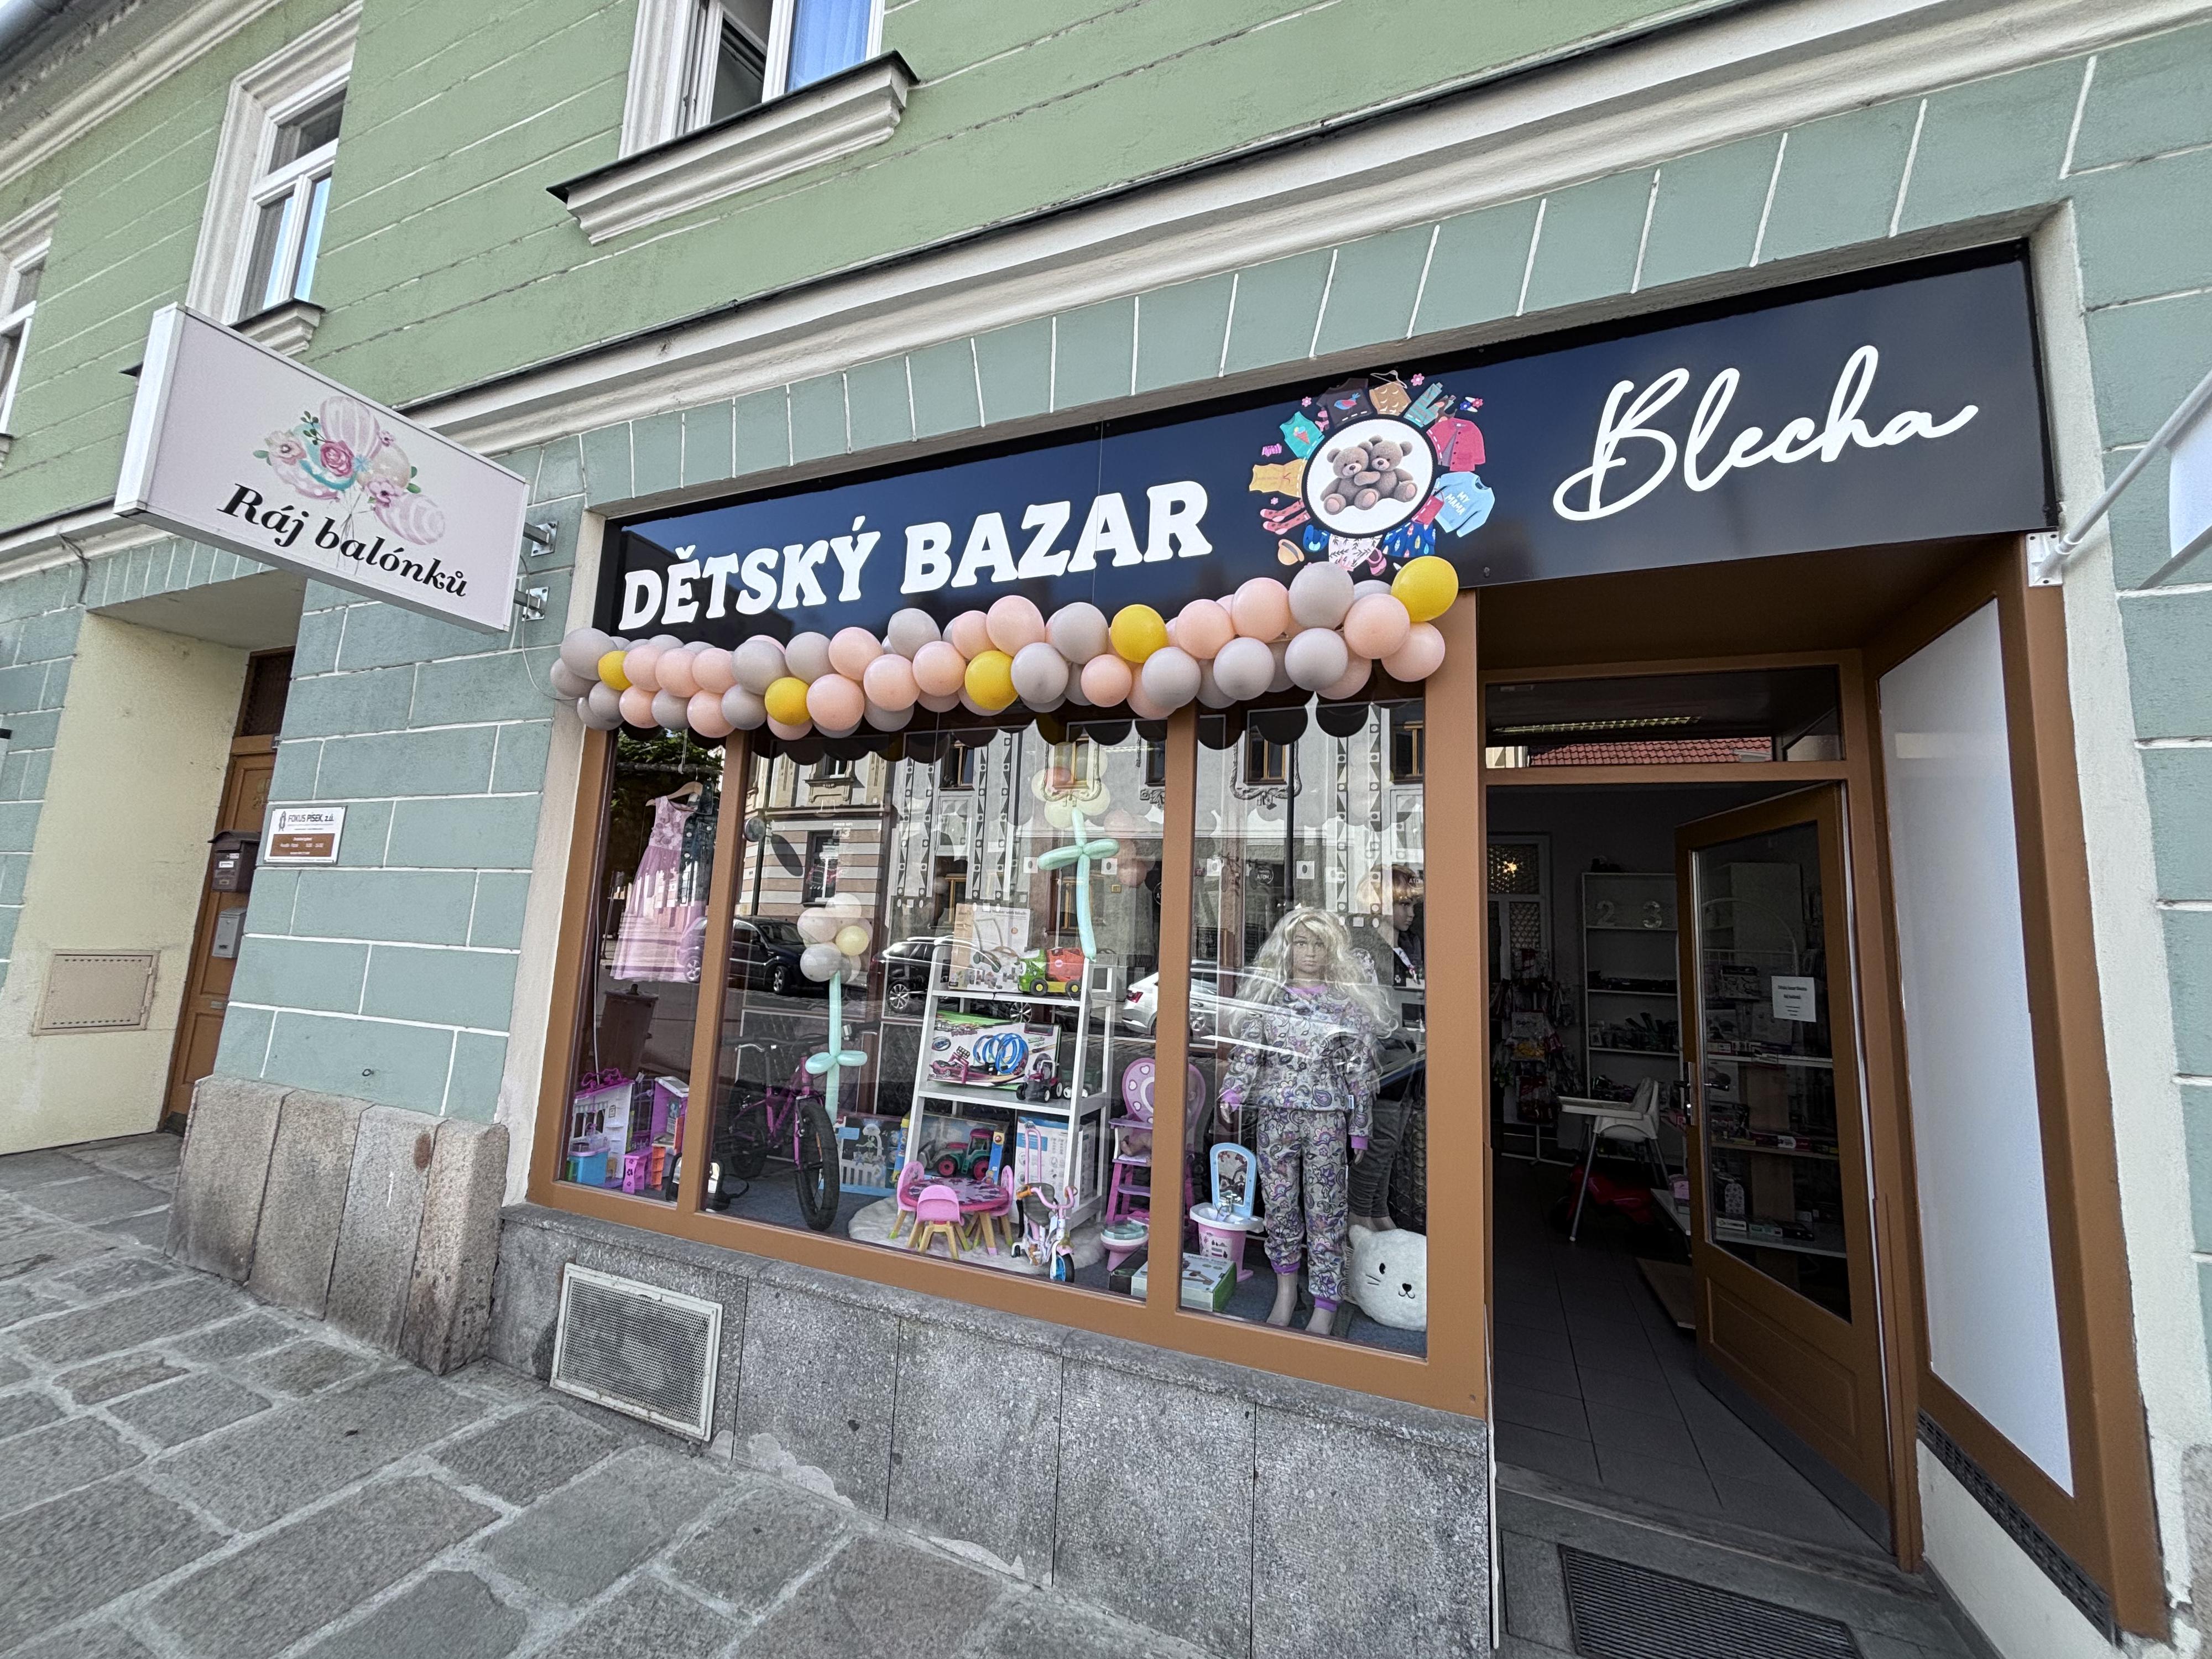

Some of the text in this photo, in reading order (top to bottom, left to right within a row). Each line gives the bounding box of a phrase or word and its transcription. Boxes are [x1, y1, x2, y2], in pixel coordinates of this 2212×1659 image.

[618, 345, 1979, 630] DĚTSKÝ BAZAR Blecha
[1444, 493, 1465, 515] MAMA
[1457, 491, 1470, 503] MY
[217, 483, 467, 597] Ráj balónků
